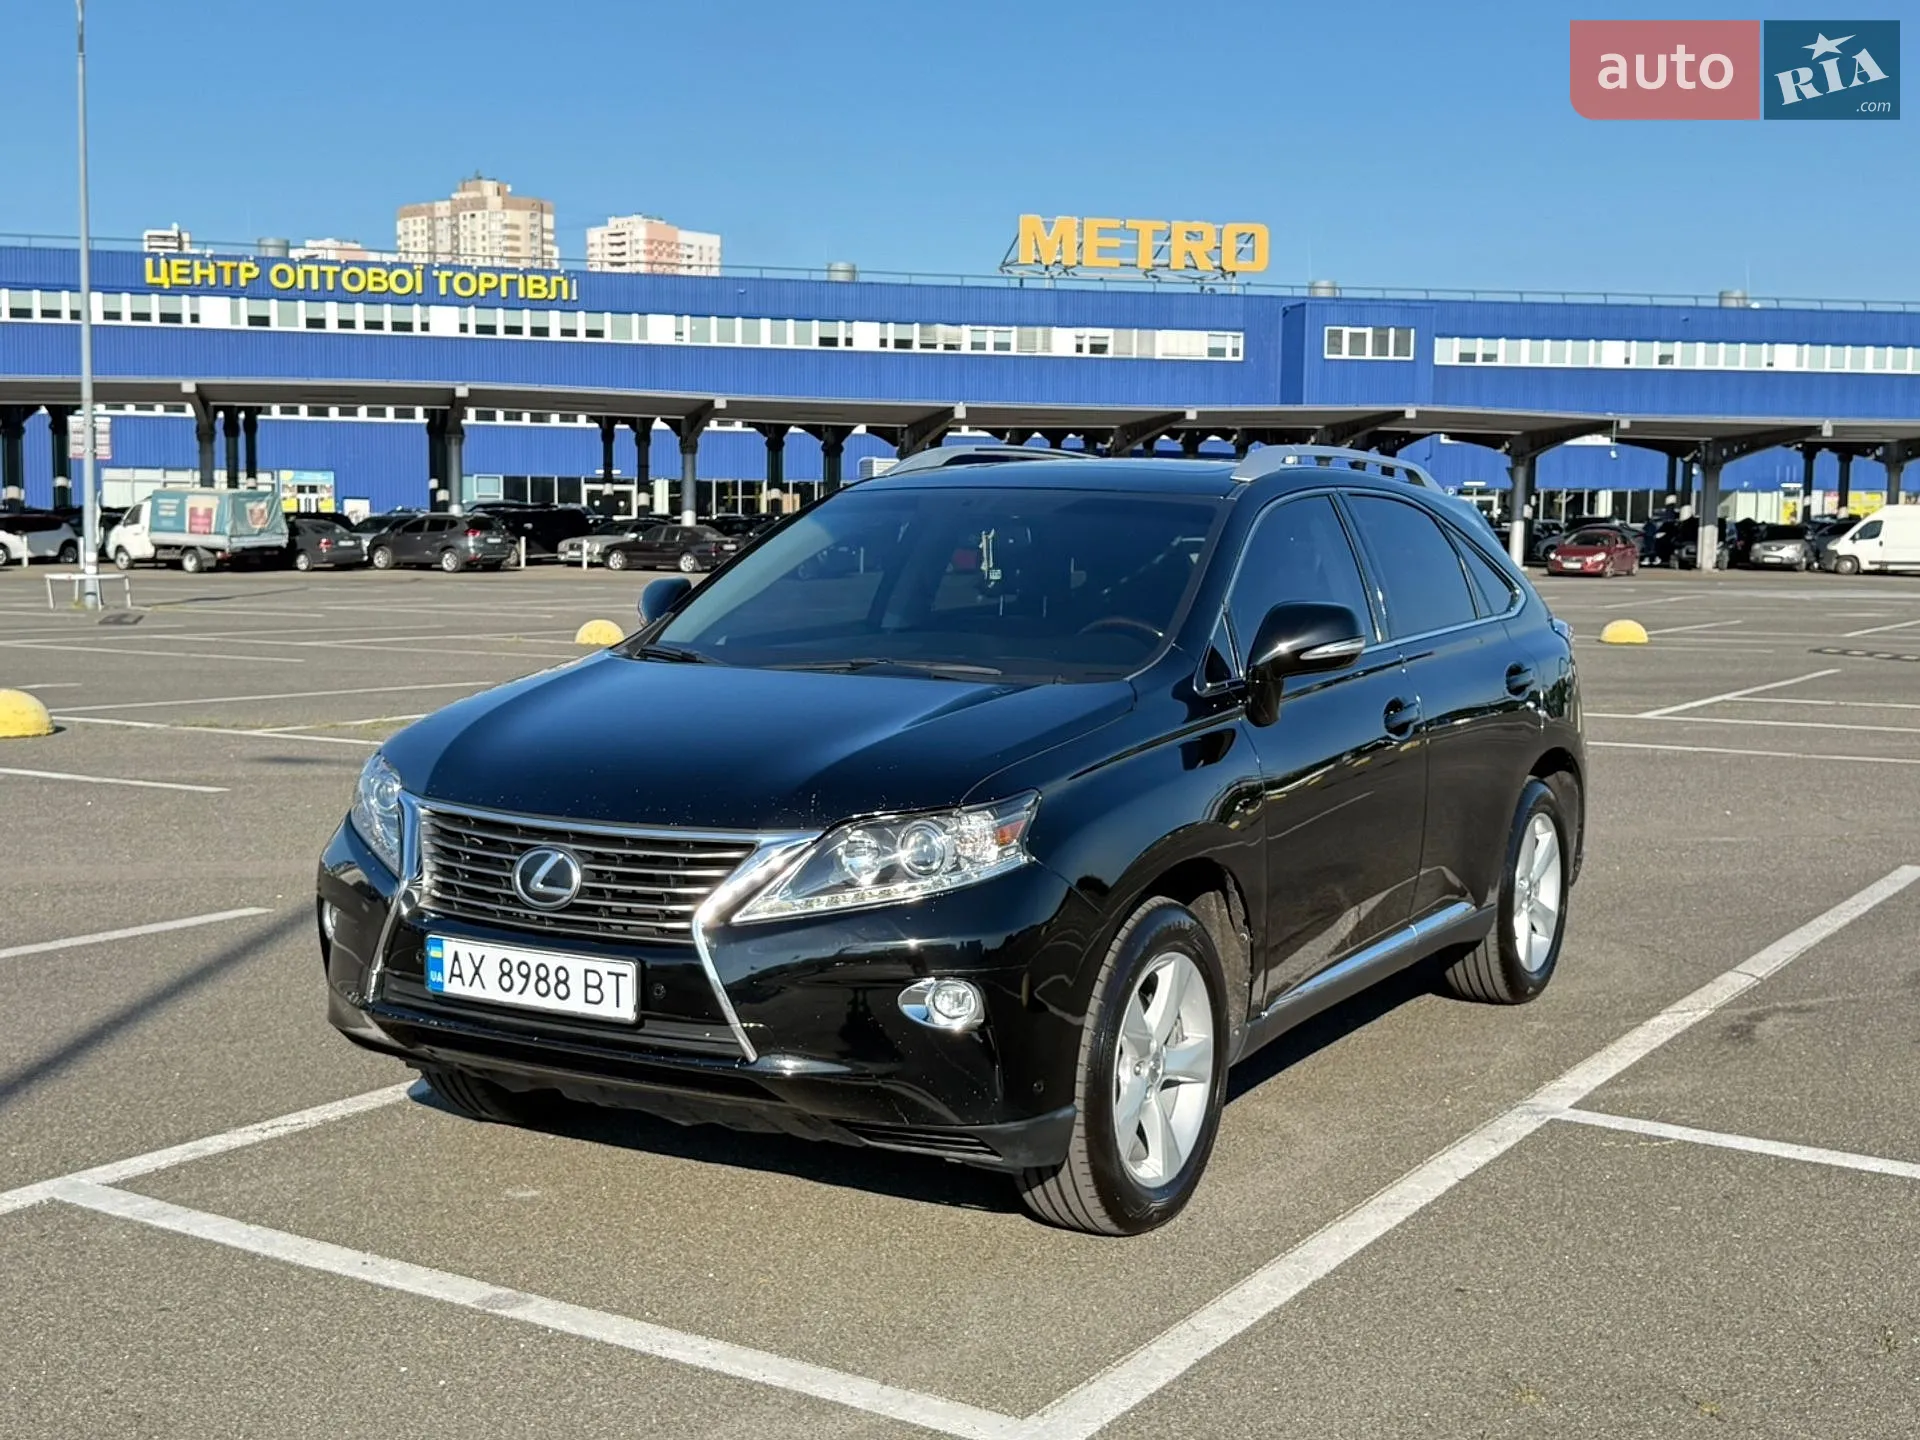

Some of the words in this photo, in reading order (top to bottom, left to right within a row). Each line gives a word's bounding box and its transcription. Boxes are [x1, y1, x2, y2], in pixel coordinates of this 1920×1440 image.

[1018, 214, 1270, 273] METRO
[145, 257, 260, 289] ЦЕНТР
[269, 263, 424, 295] ОПТОВОЇ
[430, 971, 443, 983] UA
[448, 950, 486, 990] AX
[498, 957, 571, 1001] 8988
[584, 968, 628, 1008] BT
